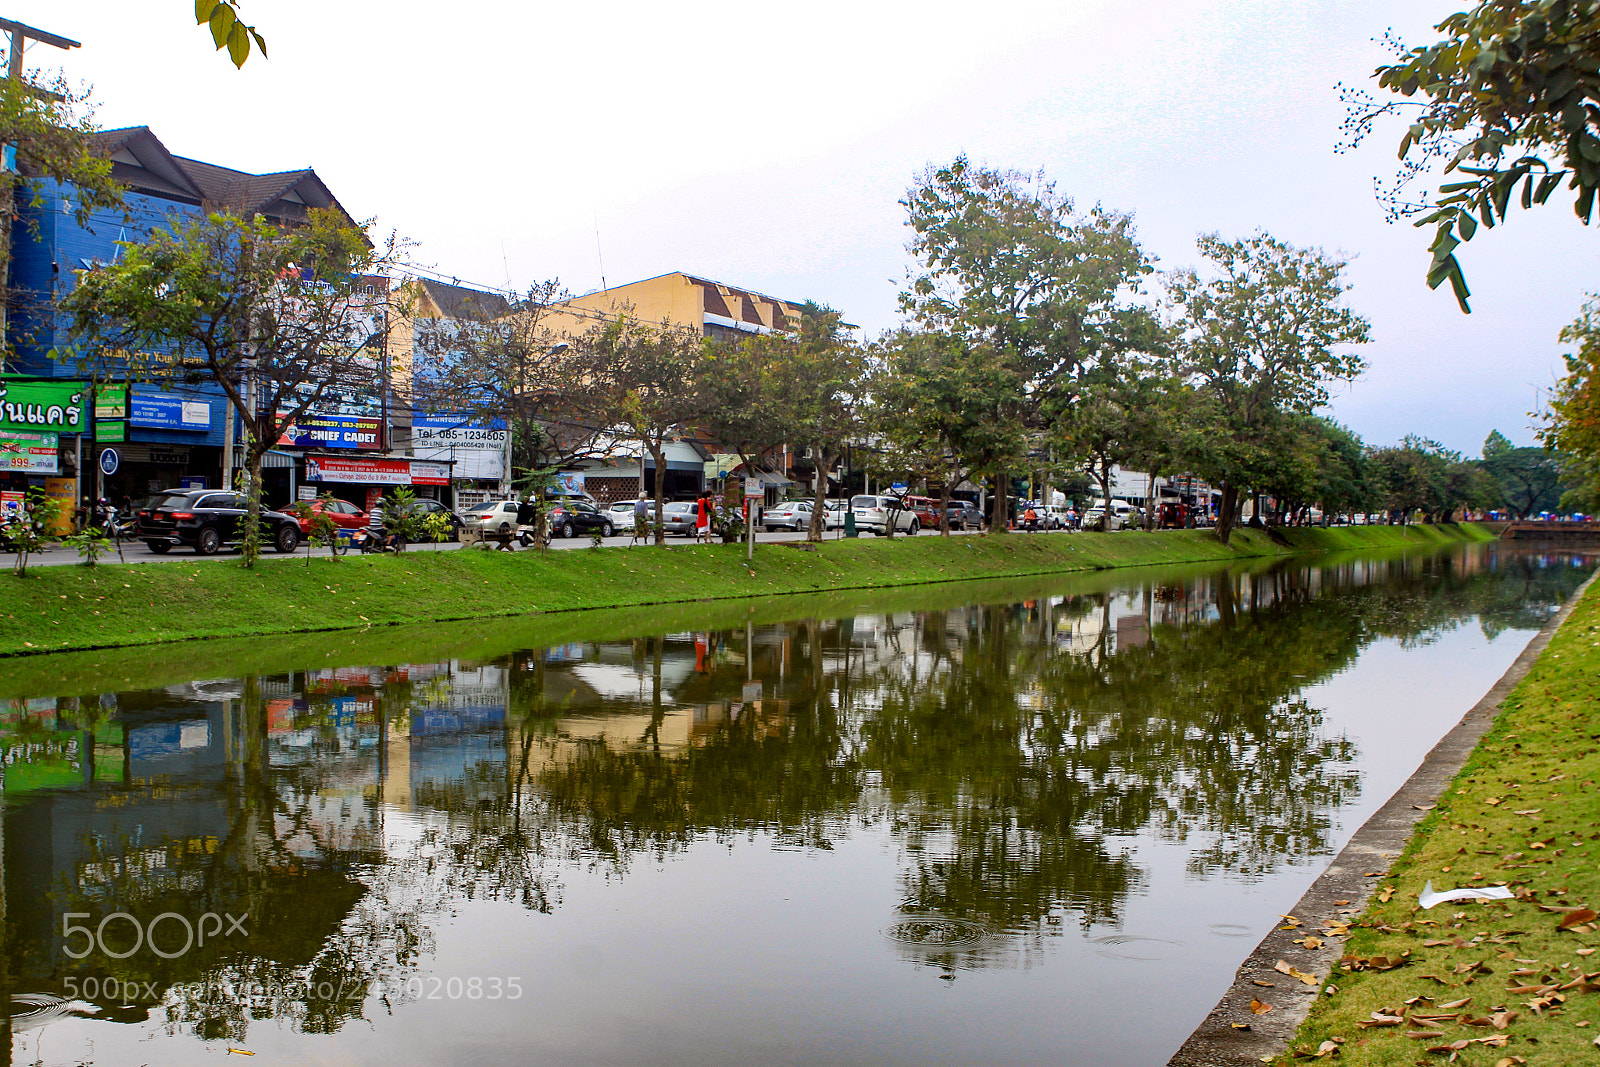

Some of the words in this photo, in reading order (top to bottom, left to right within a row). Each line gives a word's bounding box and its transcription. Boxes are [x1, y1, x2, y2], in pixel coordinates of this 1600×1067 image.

[343, 431, 377, 444] CADET
[417, 428, 436, 439] Tel.
[439, 429, 505, 441] 085-1234605
